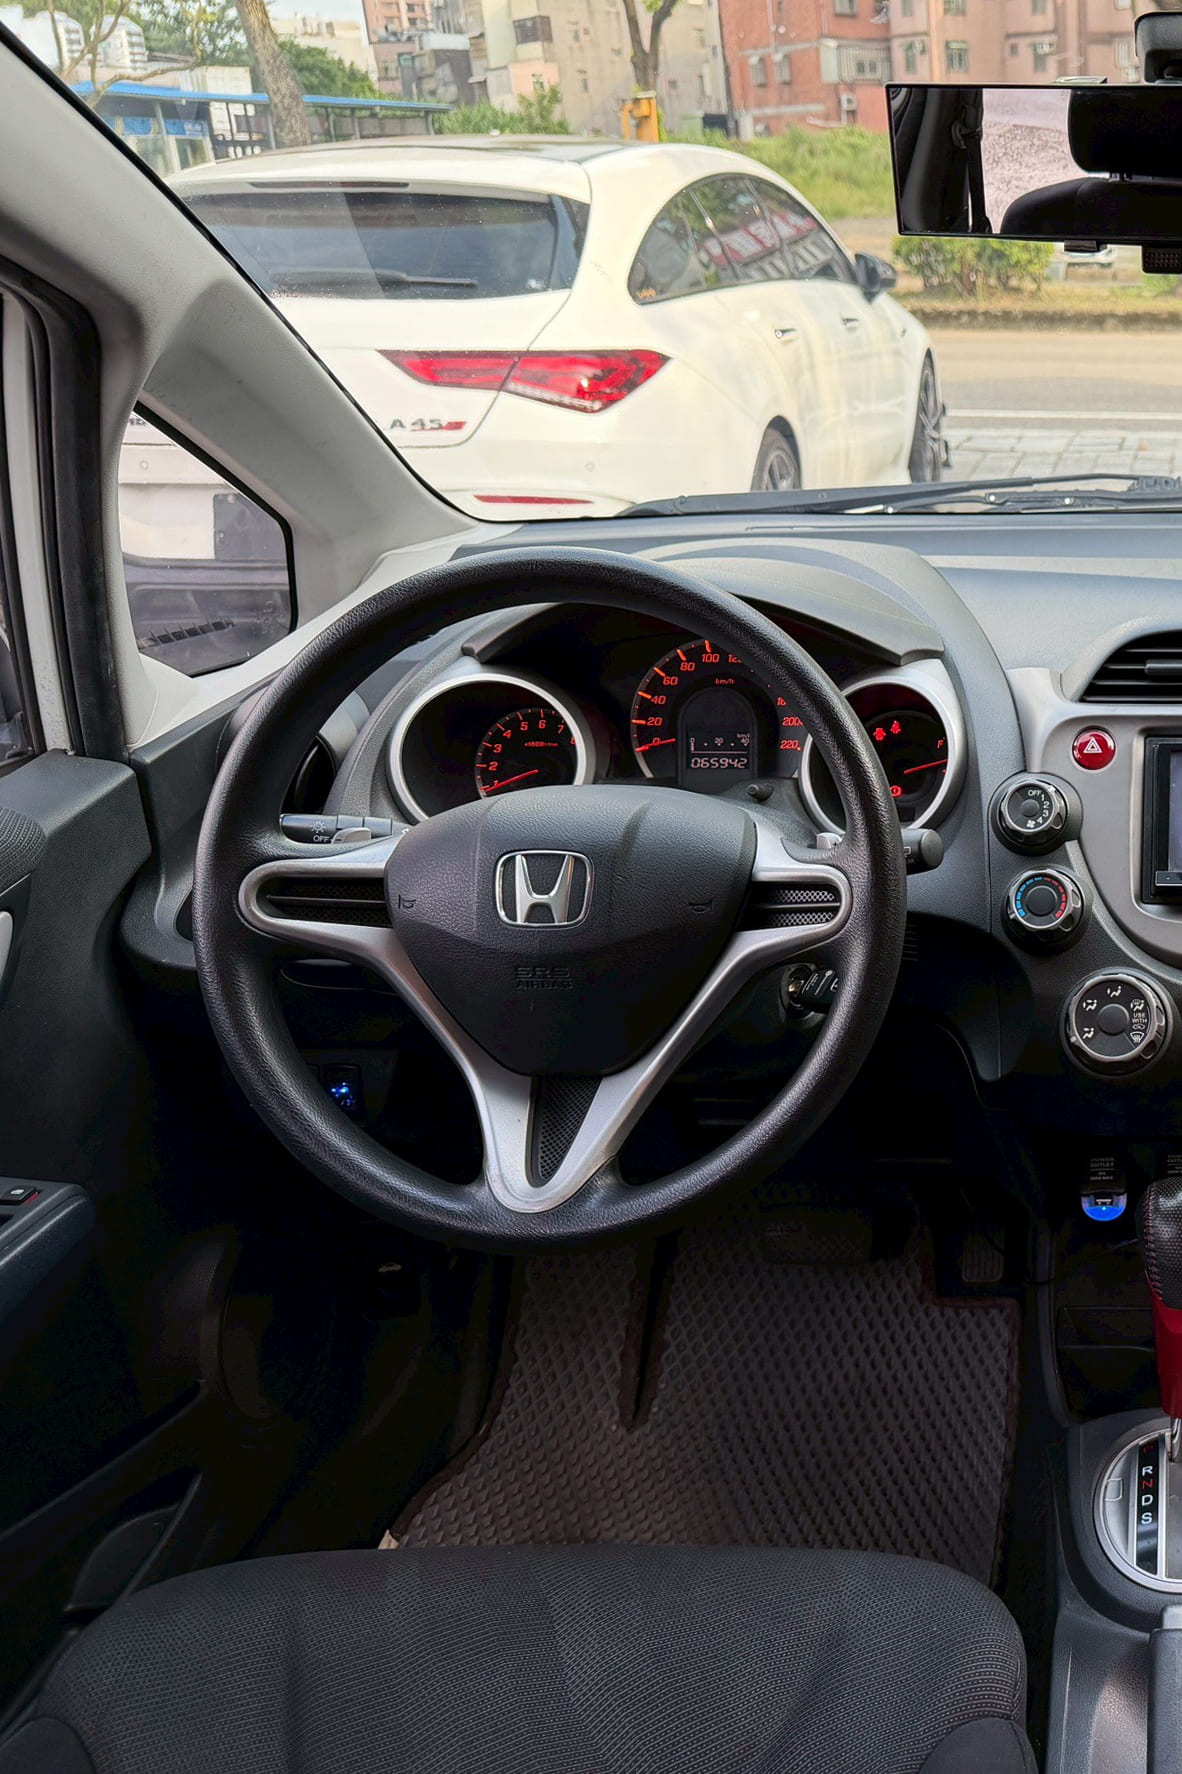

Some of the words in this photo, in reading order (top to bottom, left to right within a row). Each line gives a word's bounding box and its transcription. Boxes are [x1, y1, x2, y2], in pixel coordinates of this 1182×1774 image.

[702, 653, 720, 663] 100
[680, 662, 695, 671] 80
[663, 676, 678, 685] 60
[651, 695, 666, 704] 40
[520, 721, 528, 731] 5
[538, 720, 546, 729] 6
[647, 717, 662, 726] 20
[503, 729, 512, 739] 4
[557, 724, 565, 734] 7
[493, 743, 502, 753] 3
[780, 740, 798, 749] 220
[937, 740, 944, 749] F
[488, 761, 498, 771] 2
[690, 757, 748, 769] 065942
[1027, 789, 1041, 797] OFF
[1043, 801, 1050, 809] 2
[1042, 809, 1049, 818] 3
[1141, 1465, 1153, 1476] R
[1141, 1478, 1154, 1490] N
[1141, 1494, 1154, 1507] D
[1141, 1511, 1153, 1525] S
